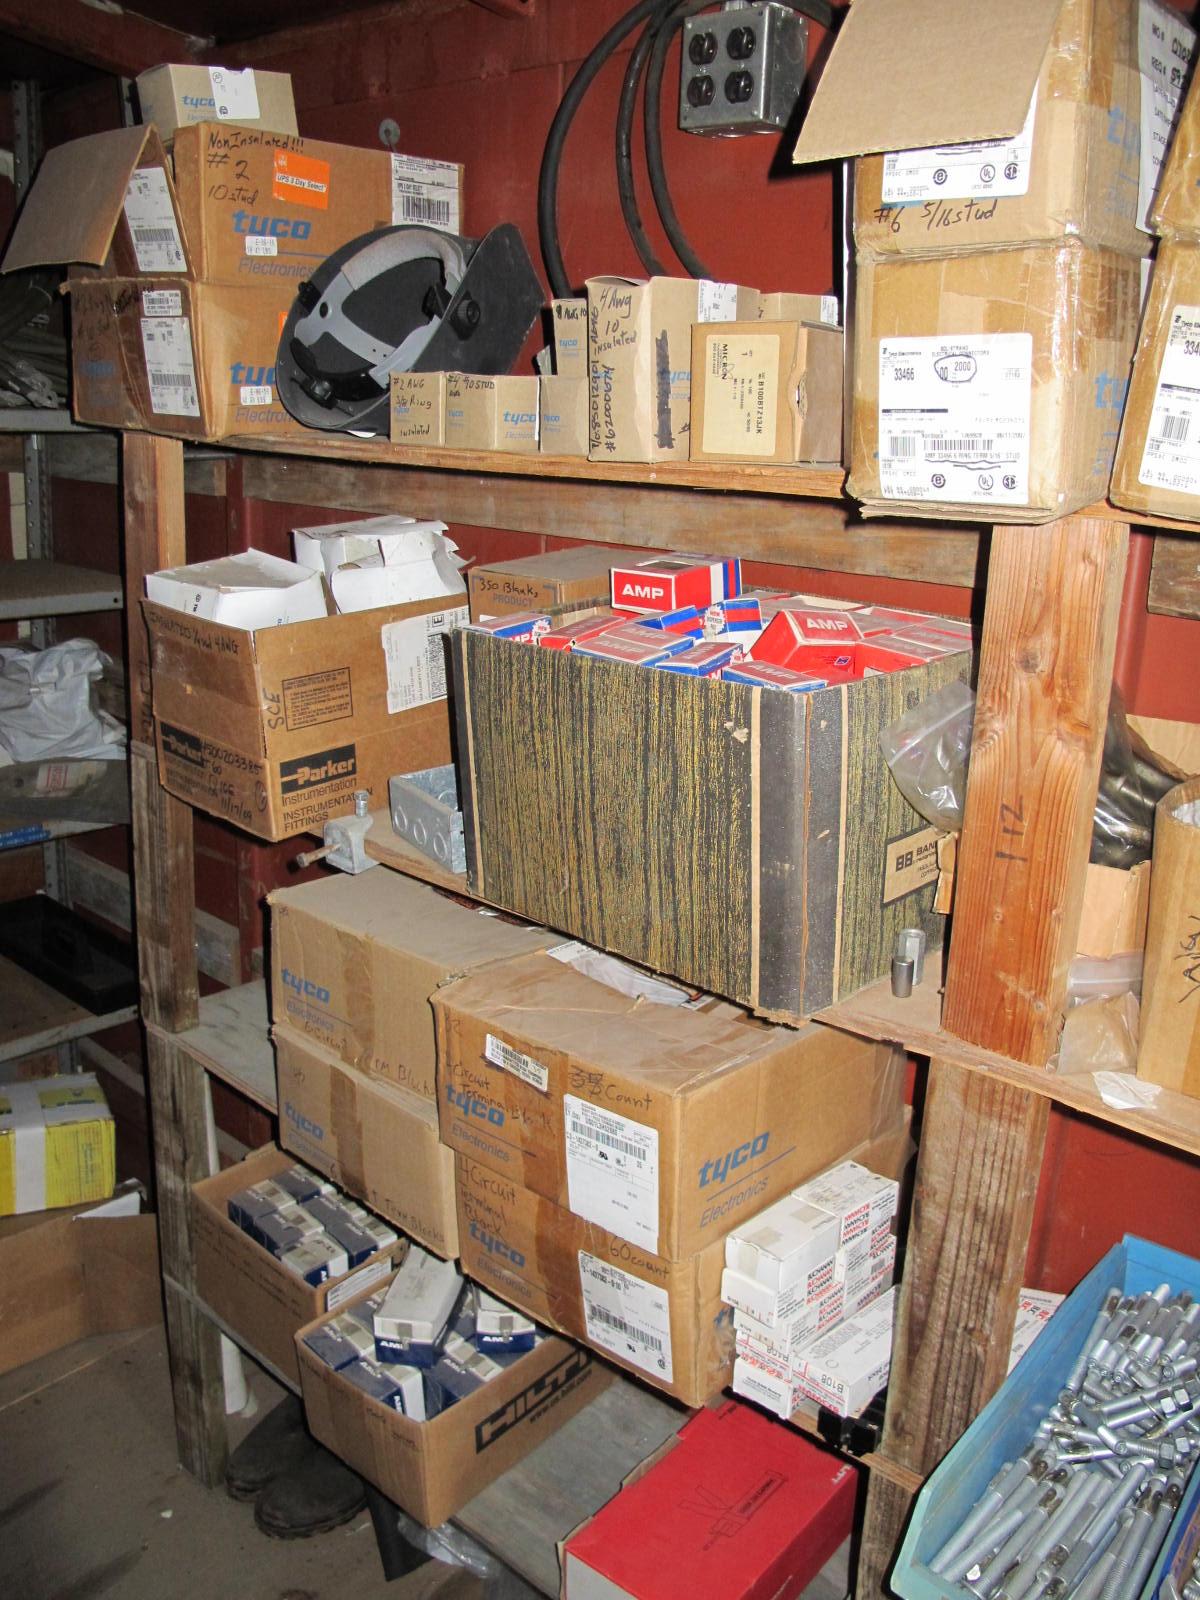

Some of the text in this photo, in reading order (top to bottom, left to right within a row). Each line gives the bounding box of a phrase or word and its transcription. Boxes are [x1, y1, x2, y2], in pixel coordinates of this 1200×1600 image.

[232, 209, 312, 240] tyco
[503, 411, 537, 425] tyco
[493, 593, 533, 607] PRODUCT
[622, 584, 664, 599] AMP
[806, 617, 848, 632] AMP
[296, 758, 354, 785] Parker
[282, 778, 357, 807] Instrumentation
[284, 811, 329, 832] FITTINGS
[281, 968, 330, 1004] tyco
[445, 1084, 505, 1128] tyco
[605, 1084, 653, 1111] Count
[285, 1102, 324, 1140] tyco
[452, 1122, 511, 1162] Electronics
[698, 1131, 770, 1188] tyco
[700, 1176, 769, 1229] Electronics
[469, 1220, 526, 1267] tyco
